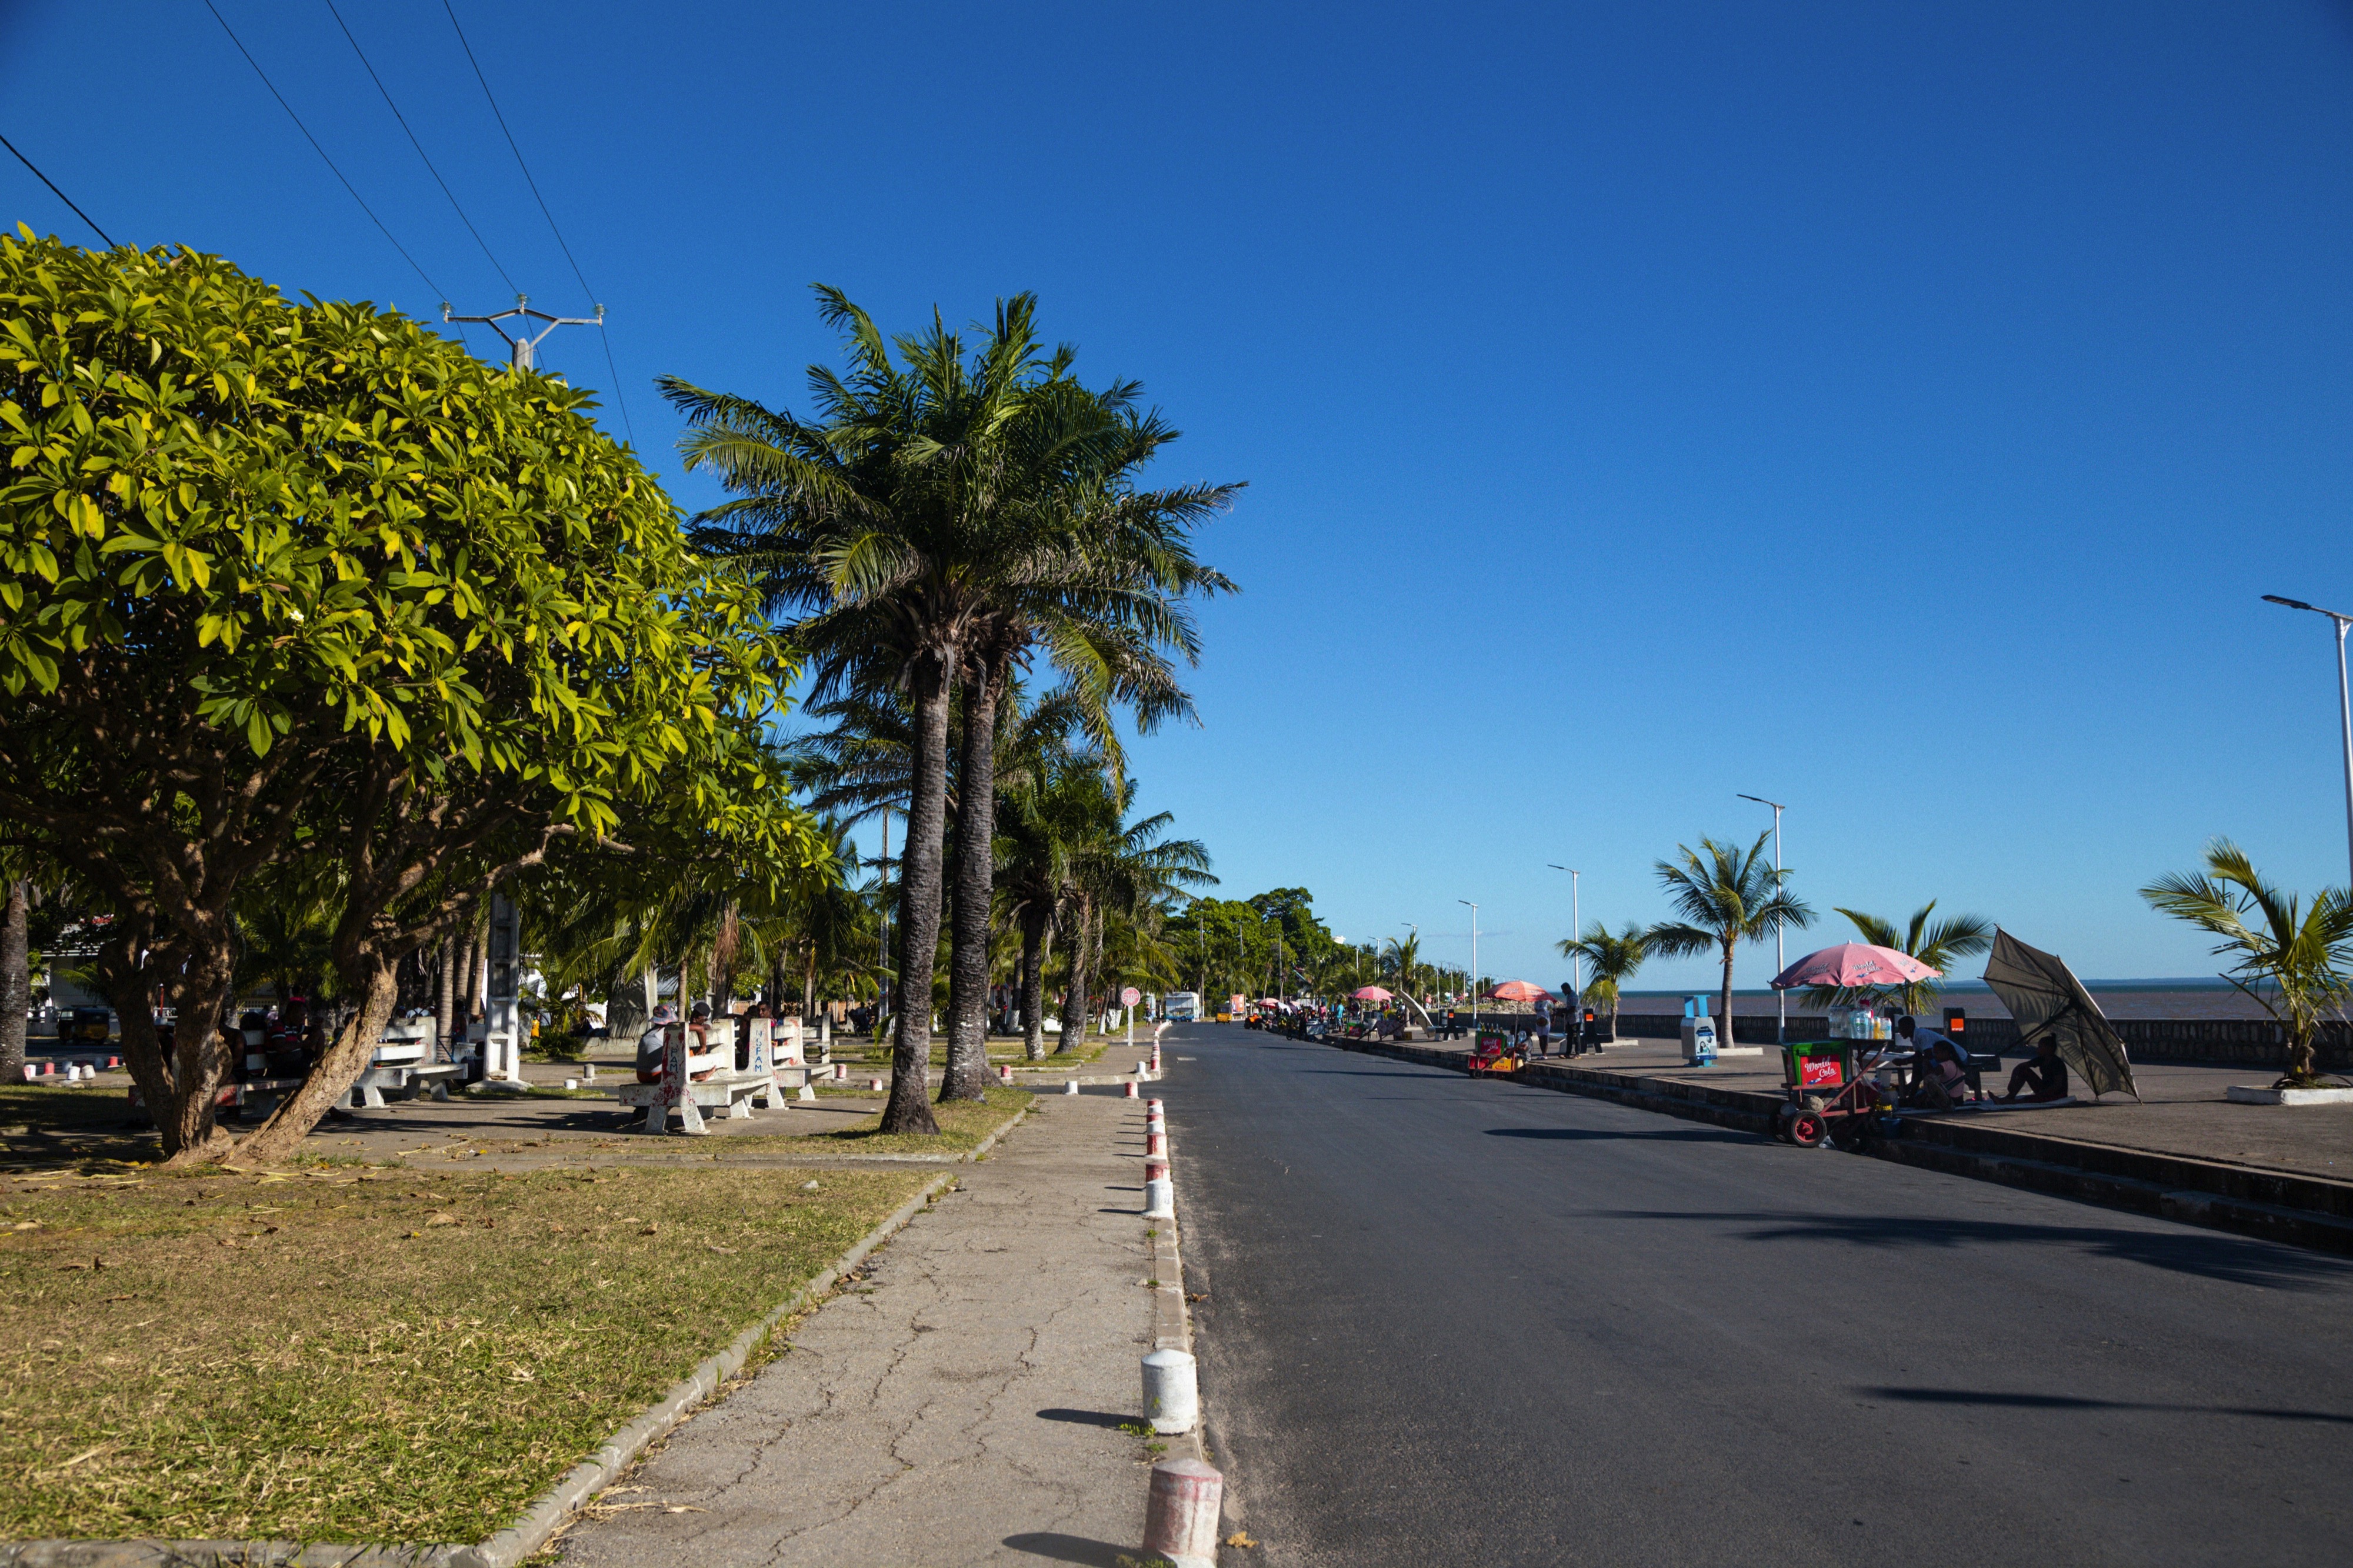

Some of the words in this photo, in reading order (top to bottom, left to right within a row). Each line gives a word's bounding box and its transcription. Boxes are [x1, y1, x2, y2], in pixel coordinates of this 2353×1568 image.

[1851, 960, 1875, 970] World
[1804, 1056, 1831, 1073] World
[1819, 1066, 1835, 1077] Cola
